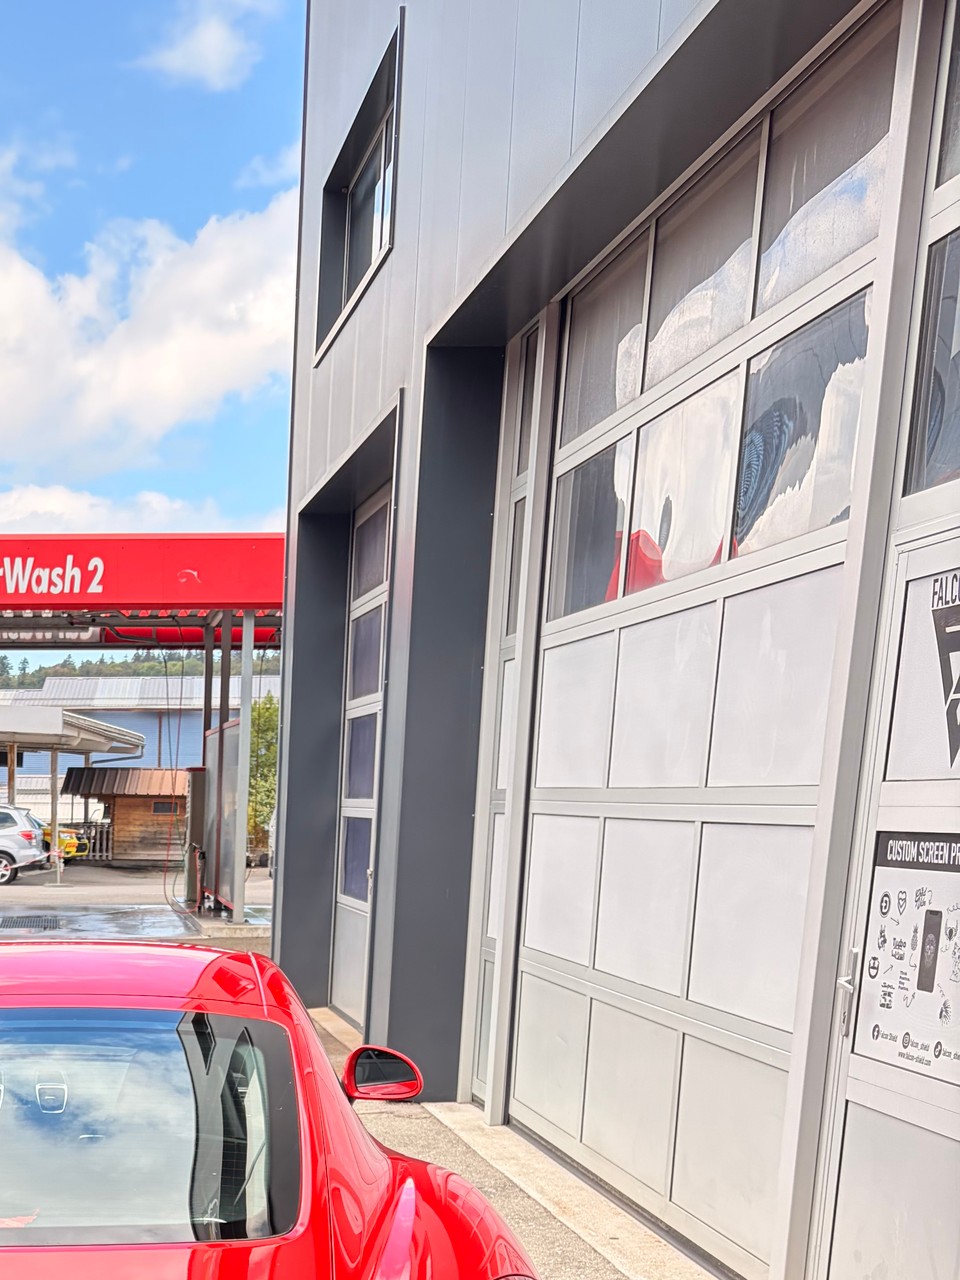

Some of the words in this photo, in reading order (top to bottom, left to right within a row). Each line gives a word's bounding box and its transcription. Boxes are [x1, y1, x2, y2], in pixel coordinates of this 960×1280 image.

[87, 557, 105, 594] 2
[931, 573, 960, 608] FALC
[887, 839, 918, 862] CUSTOM
[918, 841, 949, 864] SCREEN
